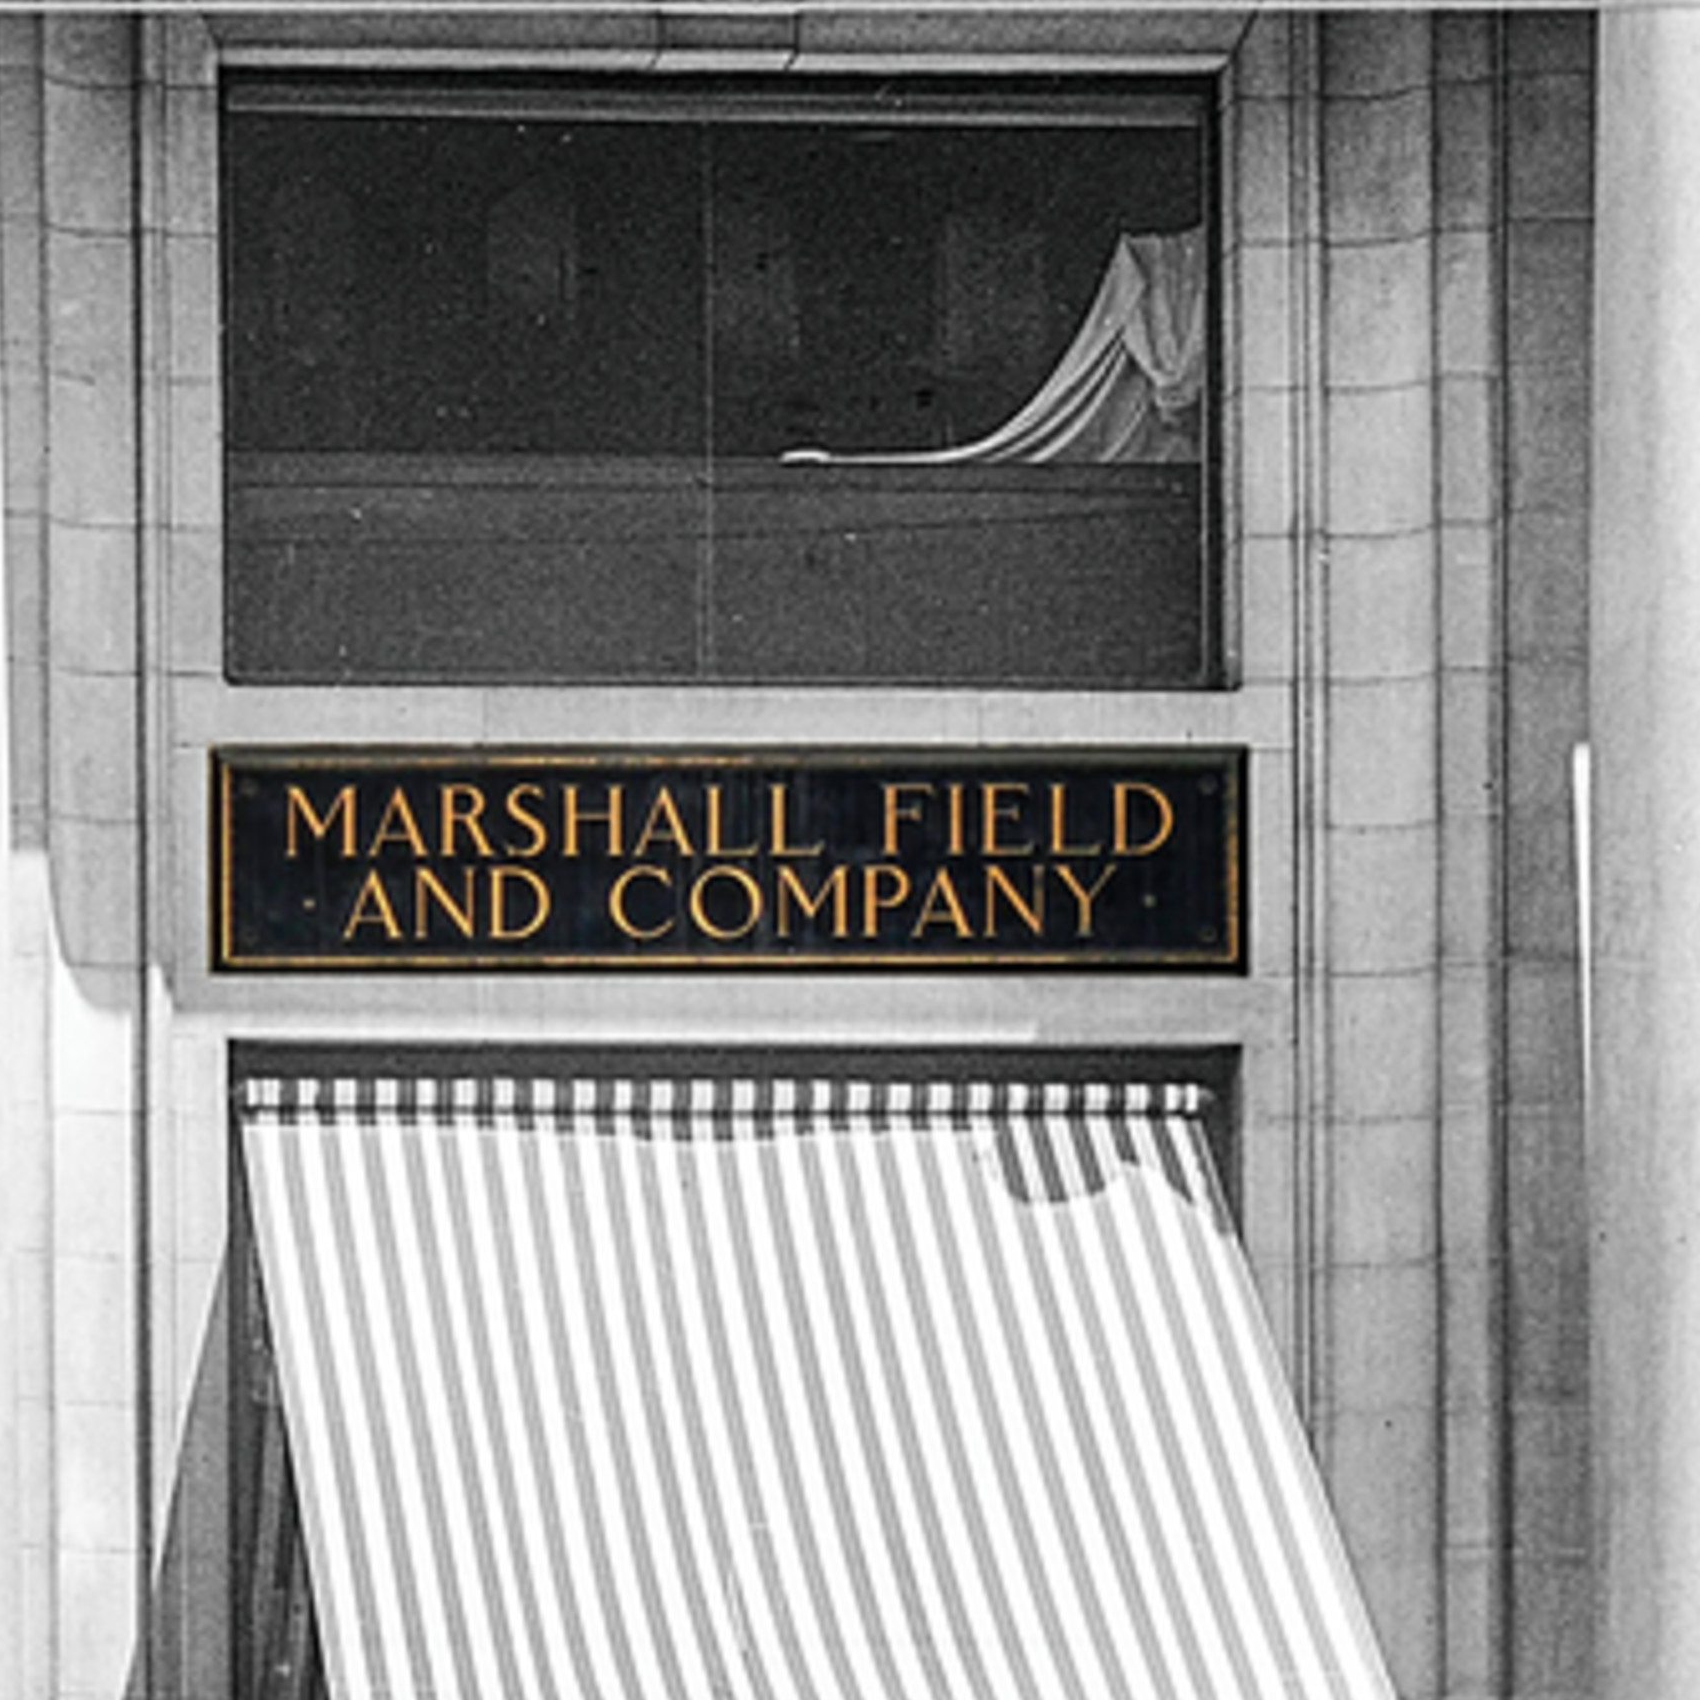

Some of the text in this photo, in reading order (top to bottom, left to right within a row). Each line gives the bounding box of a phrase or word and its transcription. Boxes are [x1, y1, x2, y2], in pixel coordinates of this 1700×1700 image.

[283, 782, 1175, 861] MARSHALL FIELD
[341, 865, 1119, 940] AND COMPANY
